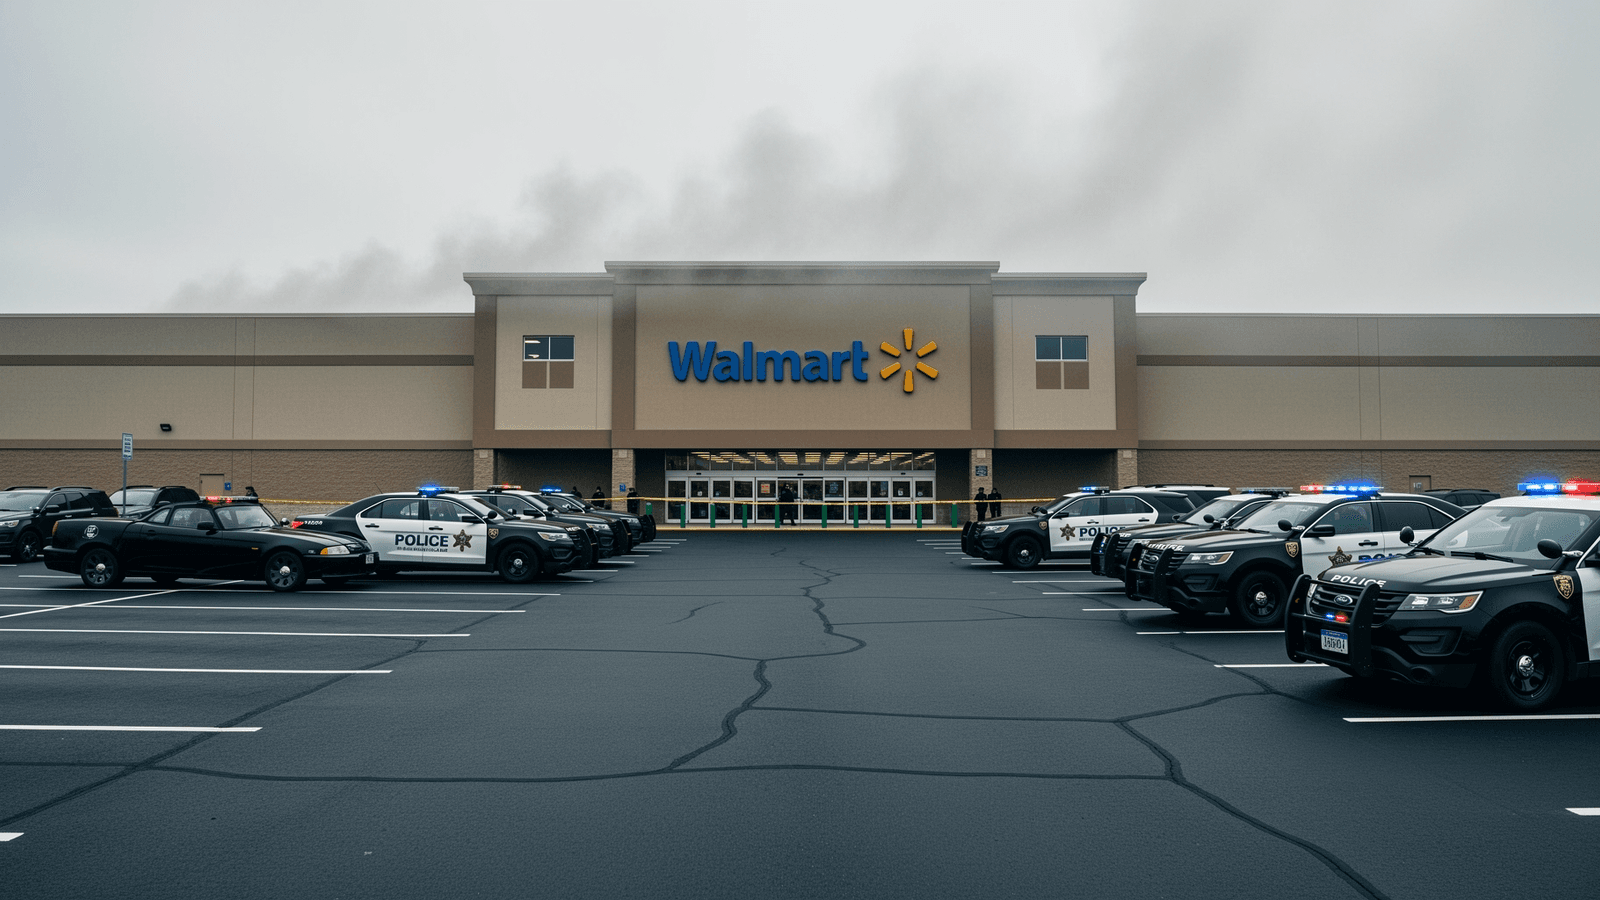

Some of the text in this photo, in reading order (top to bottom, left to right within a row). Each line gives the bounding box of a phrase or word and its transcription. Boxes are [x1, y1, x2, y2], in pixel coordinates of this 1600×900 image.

[668, 341, 869, 382] Walmart
[1080, 527, 1126, 537] POLIC
[395, 534, 449, 547] POLICE
